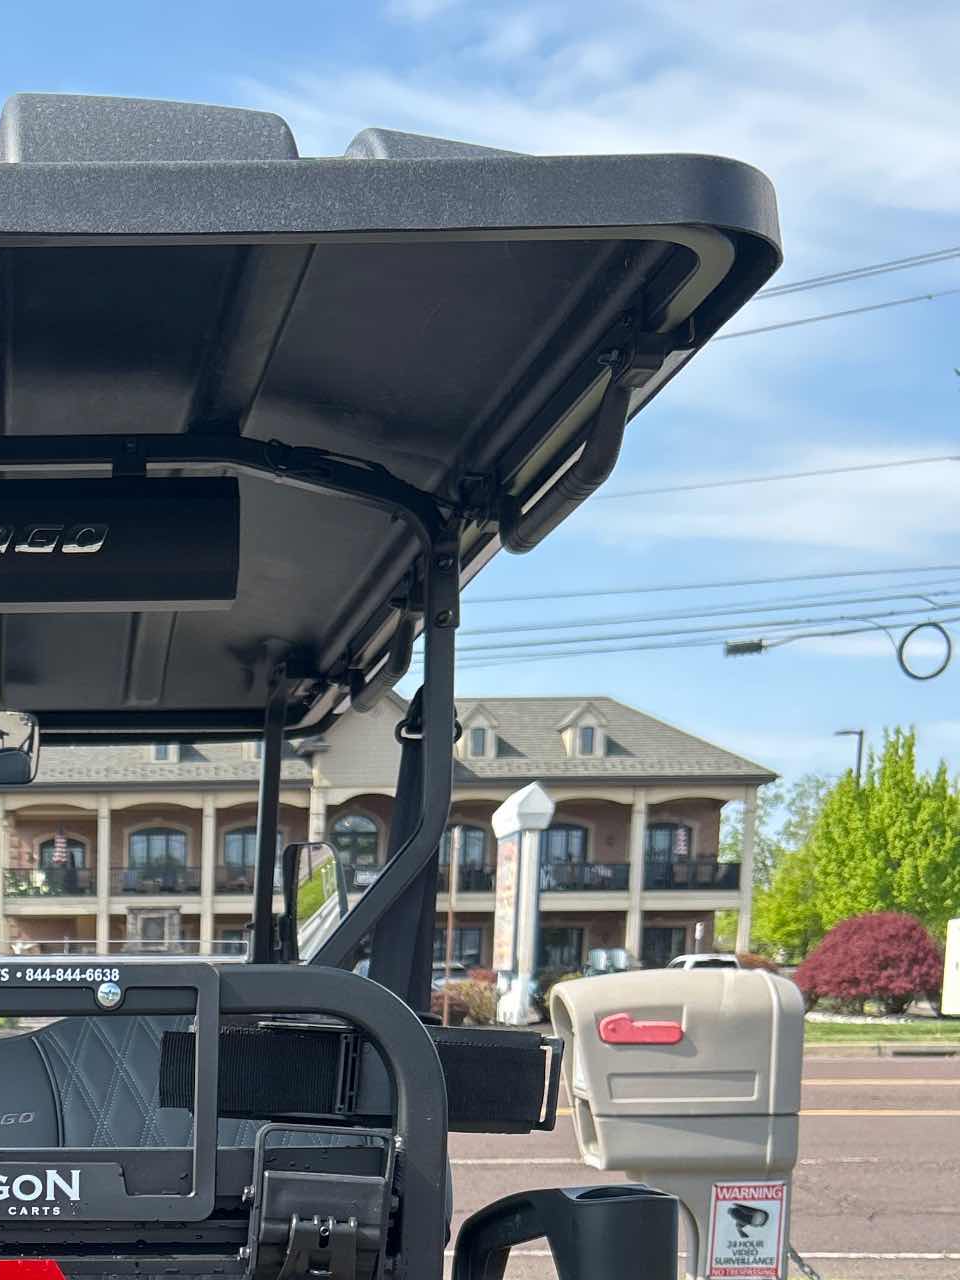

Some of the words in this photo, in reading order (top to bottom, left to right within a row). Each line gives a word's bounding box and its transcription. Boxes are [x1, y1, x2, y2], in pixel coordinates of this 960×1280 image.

[25, 969, 120, 982] 844-844-6638
[717, 1185, 782, 1200] WARNING
[8, 1206, 61, 1216] CARTS
[740, 1240, 764, 1249] HOUR
[732, 1248, 759, 1257] VIDEO
[714, 1256, 776, 1266] SURVEILLANCE
